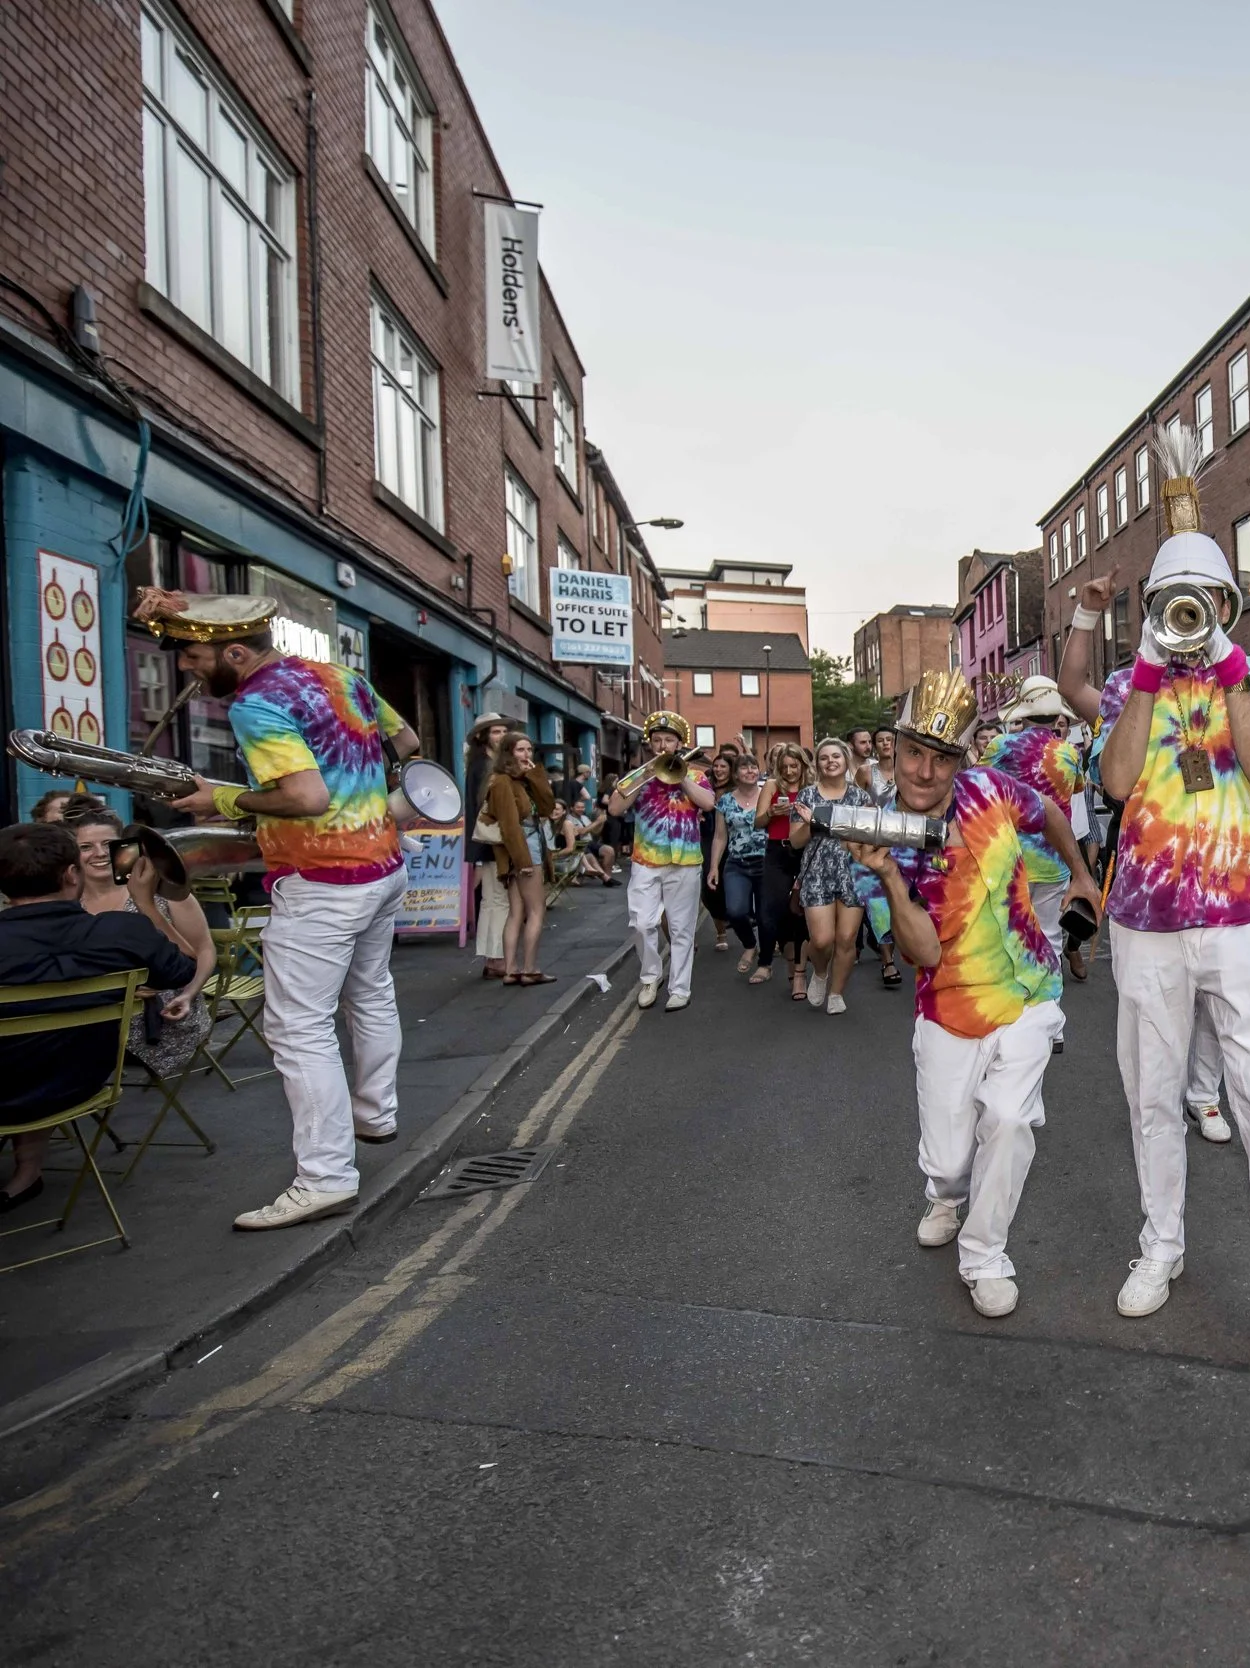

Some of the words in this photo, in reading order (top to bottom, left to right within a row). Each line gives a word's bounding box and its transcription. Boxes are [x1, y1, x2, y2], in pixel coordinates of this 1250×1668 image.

[501, 236, 524, 328] Holdens
[558, 573, 612, 589] DANIEL
[558, 585, 613, 601] HARRIS
[556, 602, 595, 615] OFFICE
[597, 606, 628, 618] SUITE
[556, 616, 585, 634] TO
[592, 620, 628, 637] LET
[407, 854, 455, 870] ENU
